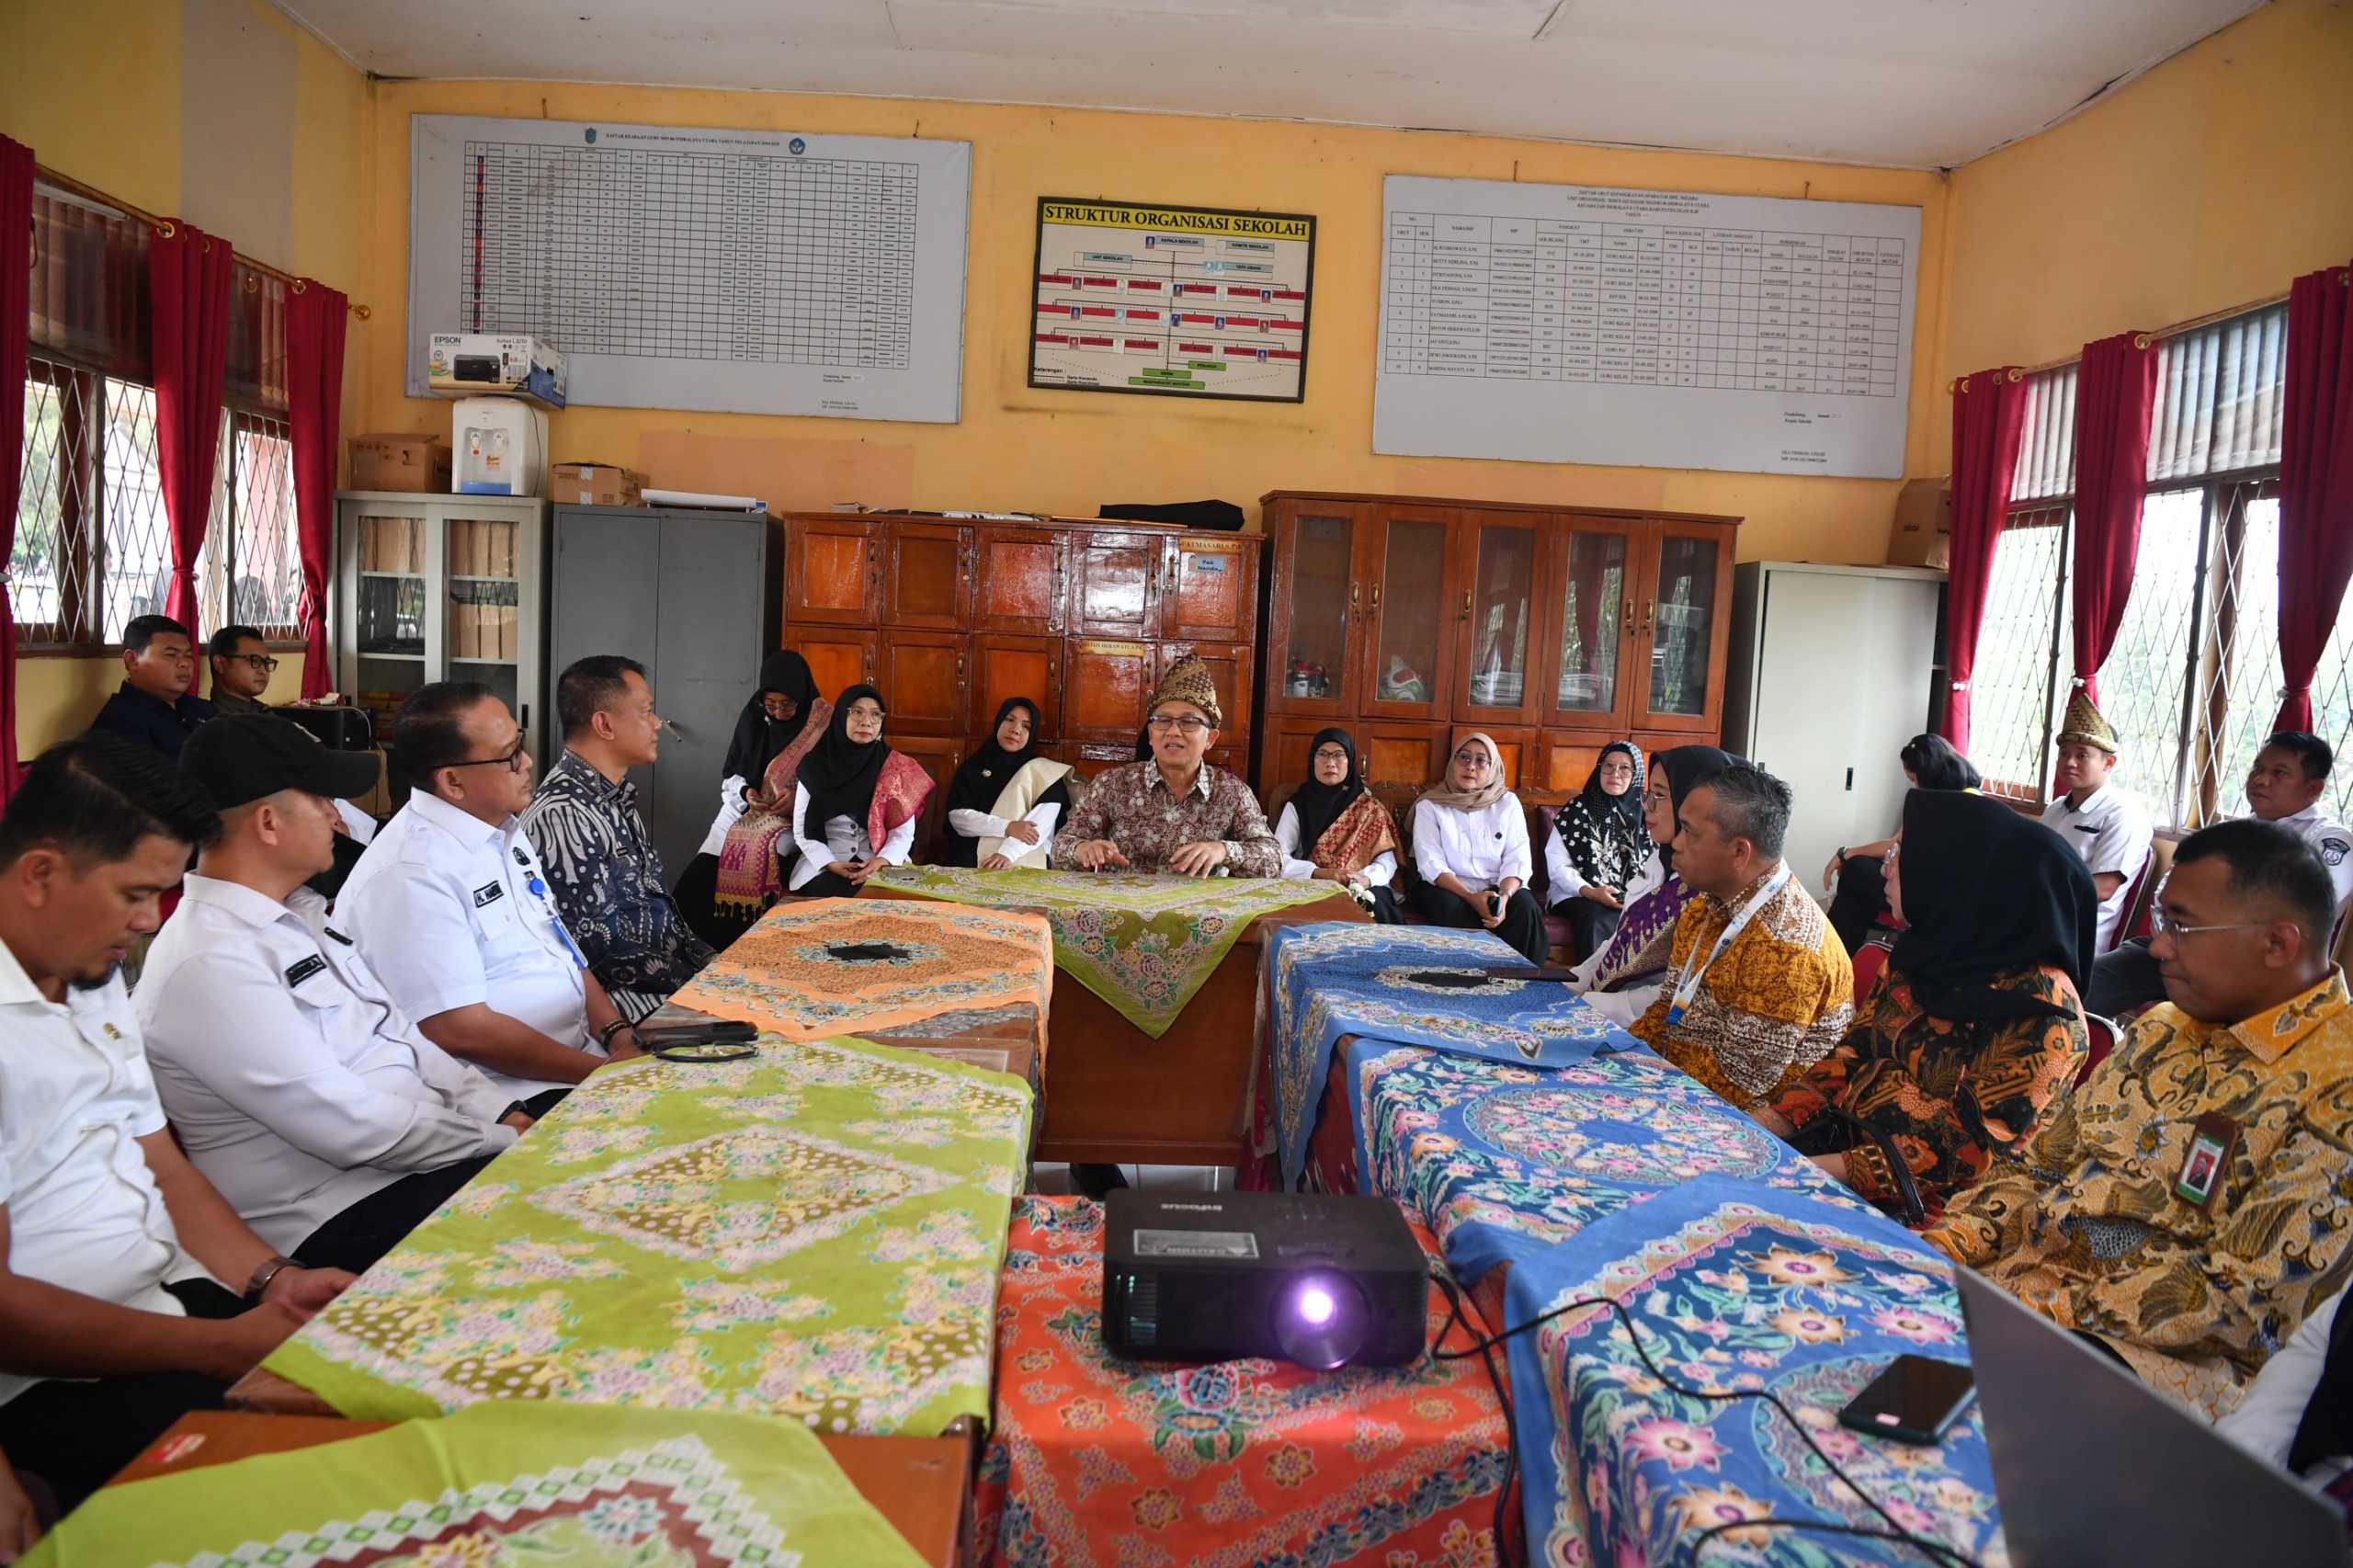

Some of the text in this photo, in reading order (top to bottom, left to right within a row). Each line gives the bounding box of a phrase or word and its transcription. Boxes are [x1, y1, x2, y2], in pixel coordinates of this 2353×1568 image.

[1044, 205, 1306, 235] STRUKTUR ORGANISASI SEKOLAH
[1161, 1203, 1222, 1211] InFocus
[1166, 1247, 1226, 1256] CAUTION
